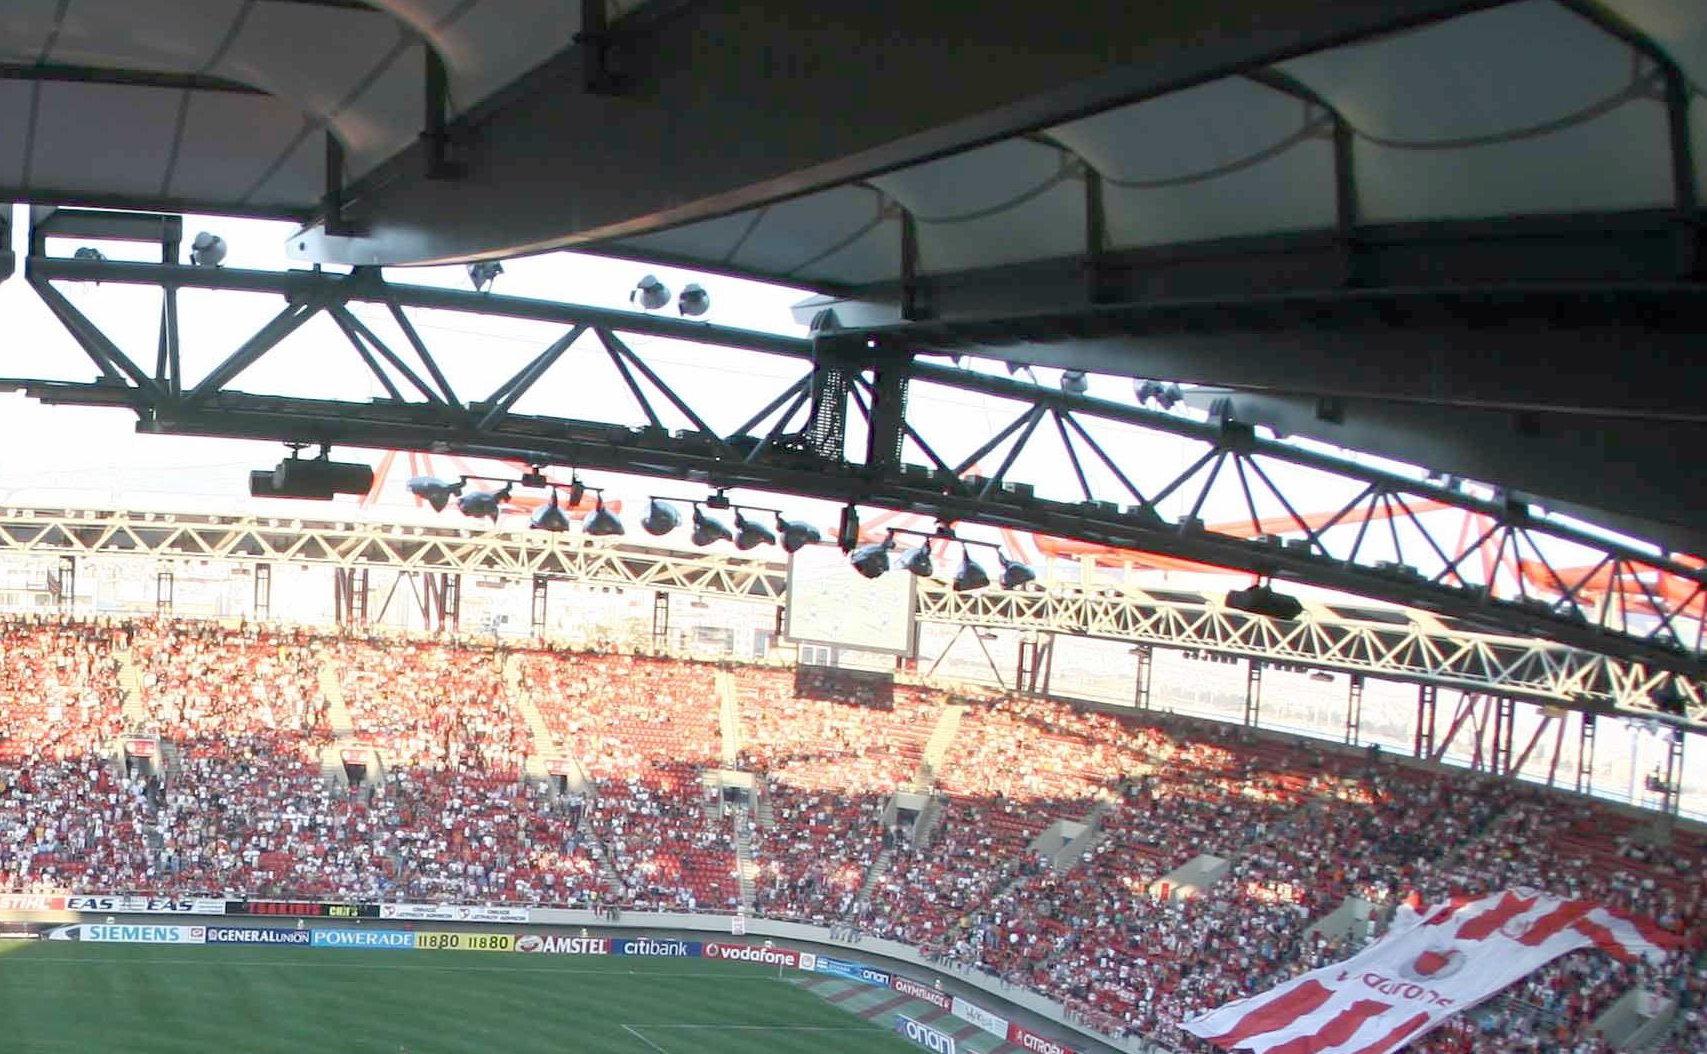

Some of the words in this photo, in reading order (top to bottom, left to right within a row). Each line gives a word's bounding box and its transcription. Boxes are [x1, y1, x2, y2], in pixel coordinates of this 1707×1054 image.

[67, 897, 114, 910] EAS
[146, 898, 193, 911] EAS
[89, 926, 180, 941] SIEMENS
[314, 931, 413, 946] POWERADE
[468, 935, 509, 950] 11880
[542, 937, 607, 954] AMSTEL
[624, 938, 687, 957] citibank
[720, 944, 794, 966] vodafone
